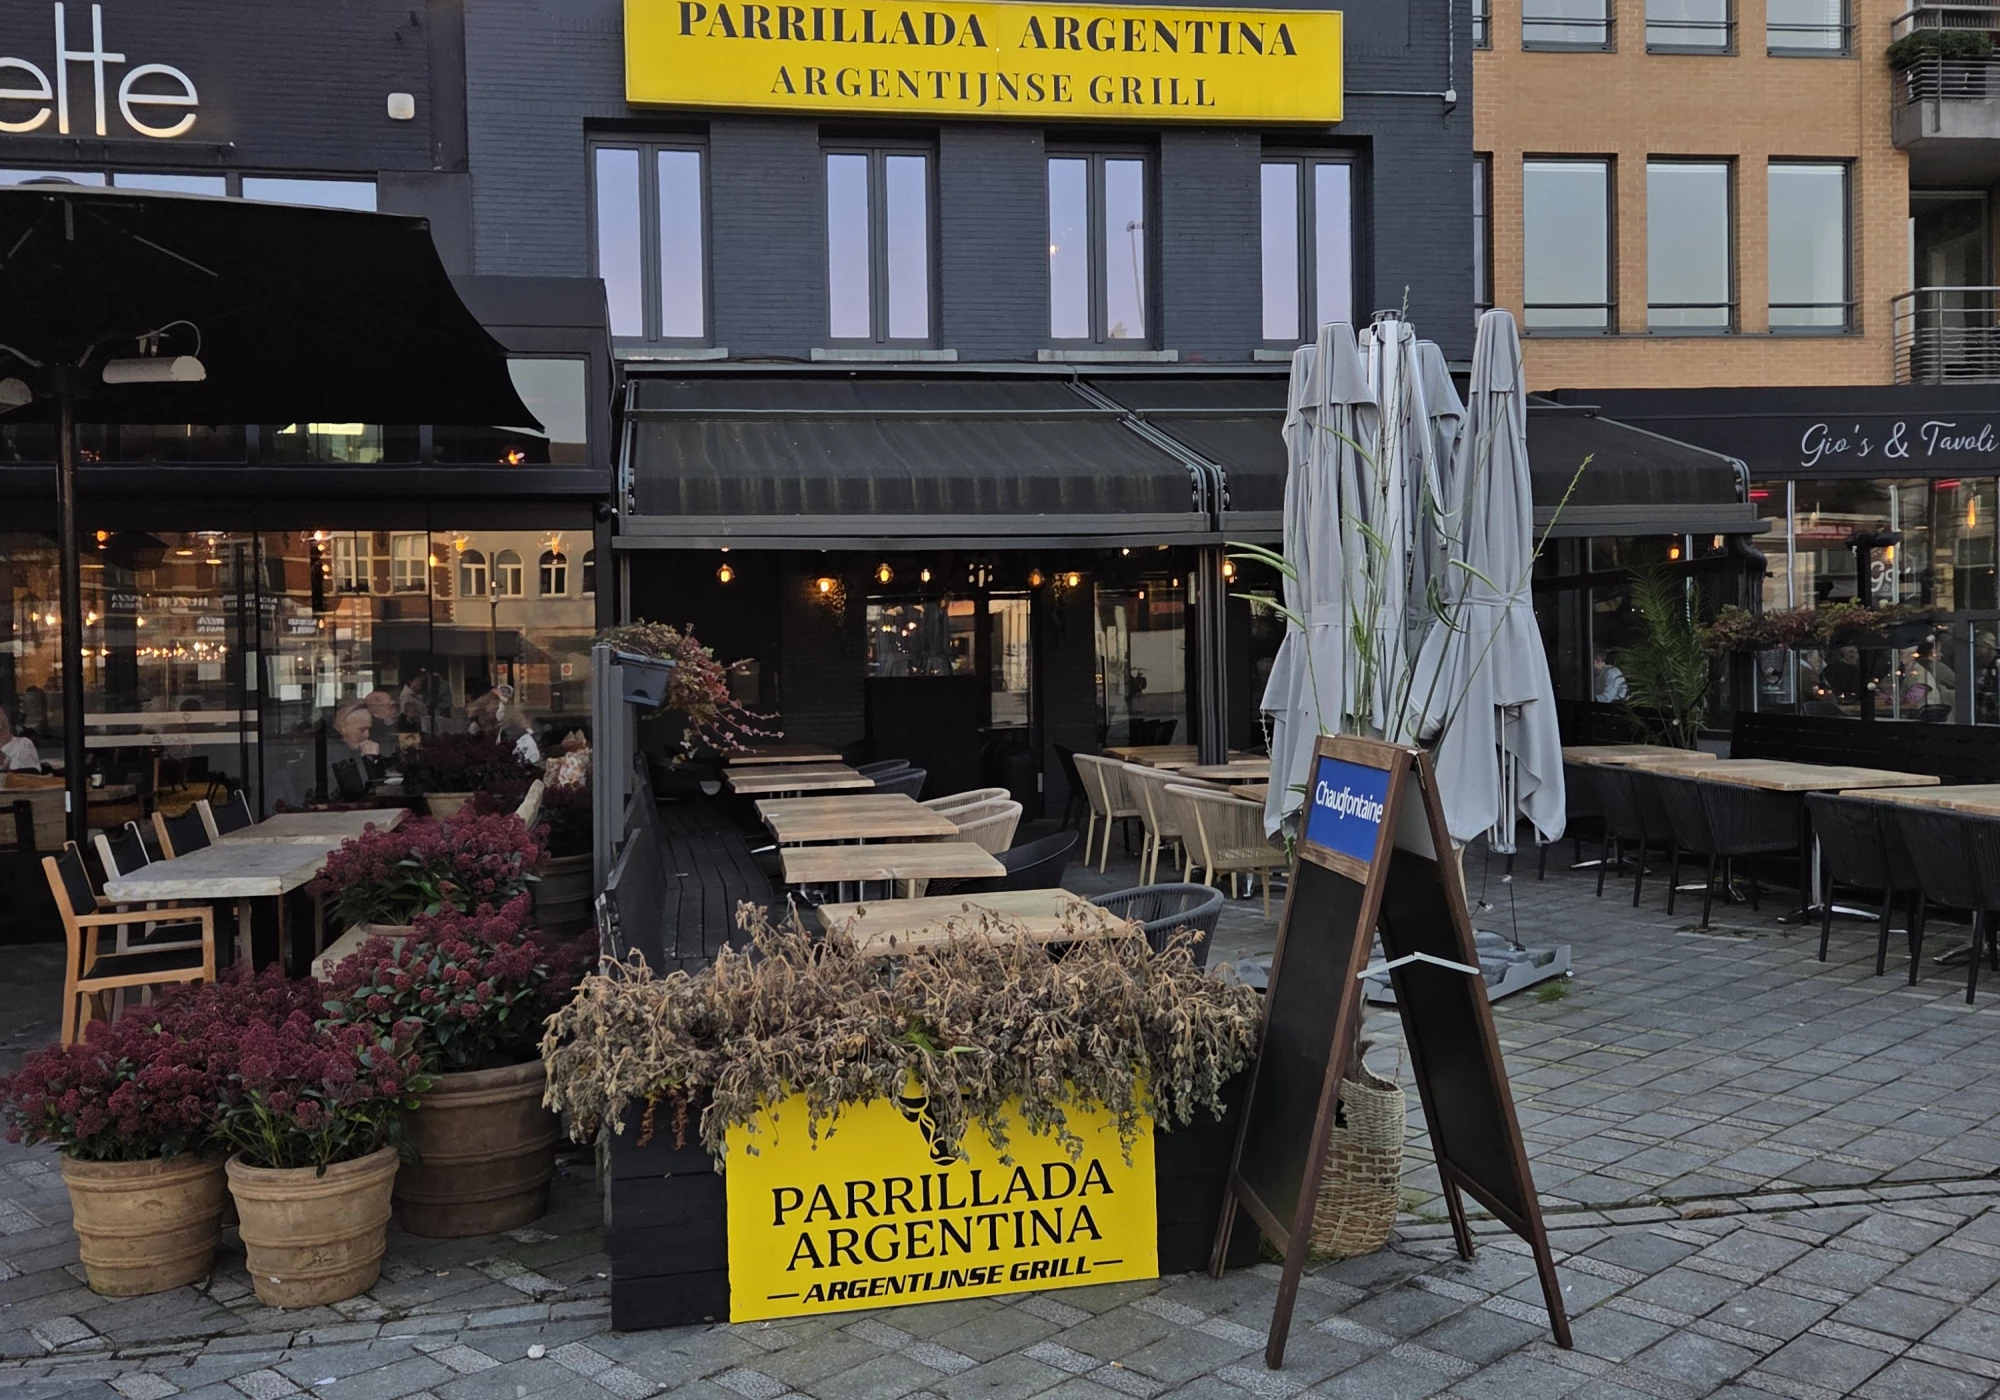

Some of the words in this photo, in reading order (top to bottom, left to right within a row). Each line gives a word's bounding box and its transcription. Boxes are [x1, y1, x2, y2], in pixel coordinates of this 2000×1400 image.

[677, 1, 989, 47] PARRILLADA
[1018, 15, 1298, 56] ARGENTINA
[770, 65, 1073, 107] ARGENTIJNSE
[1089, 75, 1217, 107] GRILL
[1800, 423, 1875, 467] Gio's
[1884, 421, 1909, 458] &
[1920, 420, 2000, 457] Tavoli
[1315, 780, 1384, 824] Chaudfontaine
[772, 1158, 1115, 1226] PARRILLADA
[785, 1204, 1104, 1272] ARGENTINA
[802, 1264, 1005, 1304] ARGENTIJNSE
[1009, 1255, 1093, 1282] GRILL
